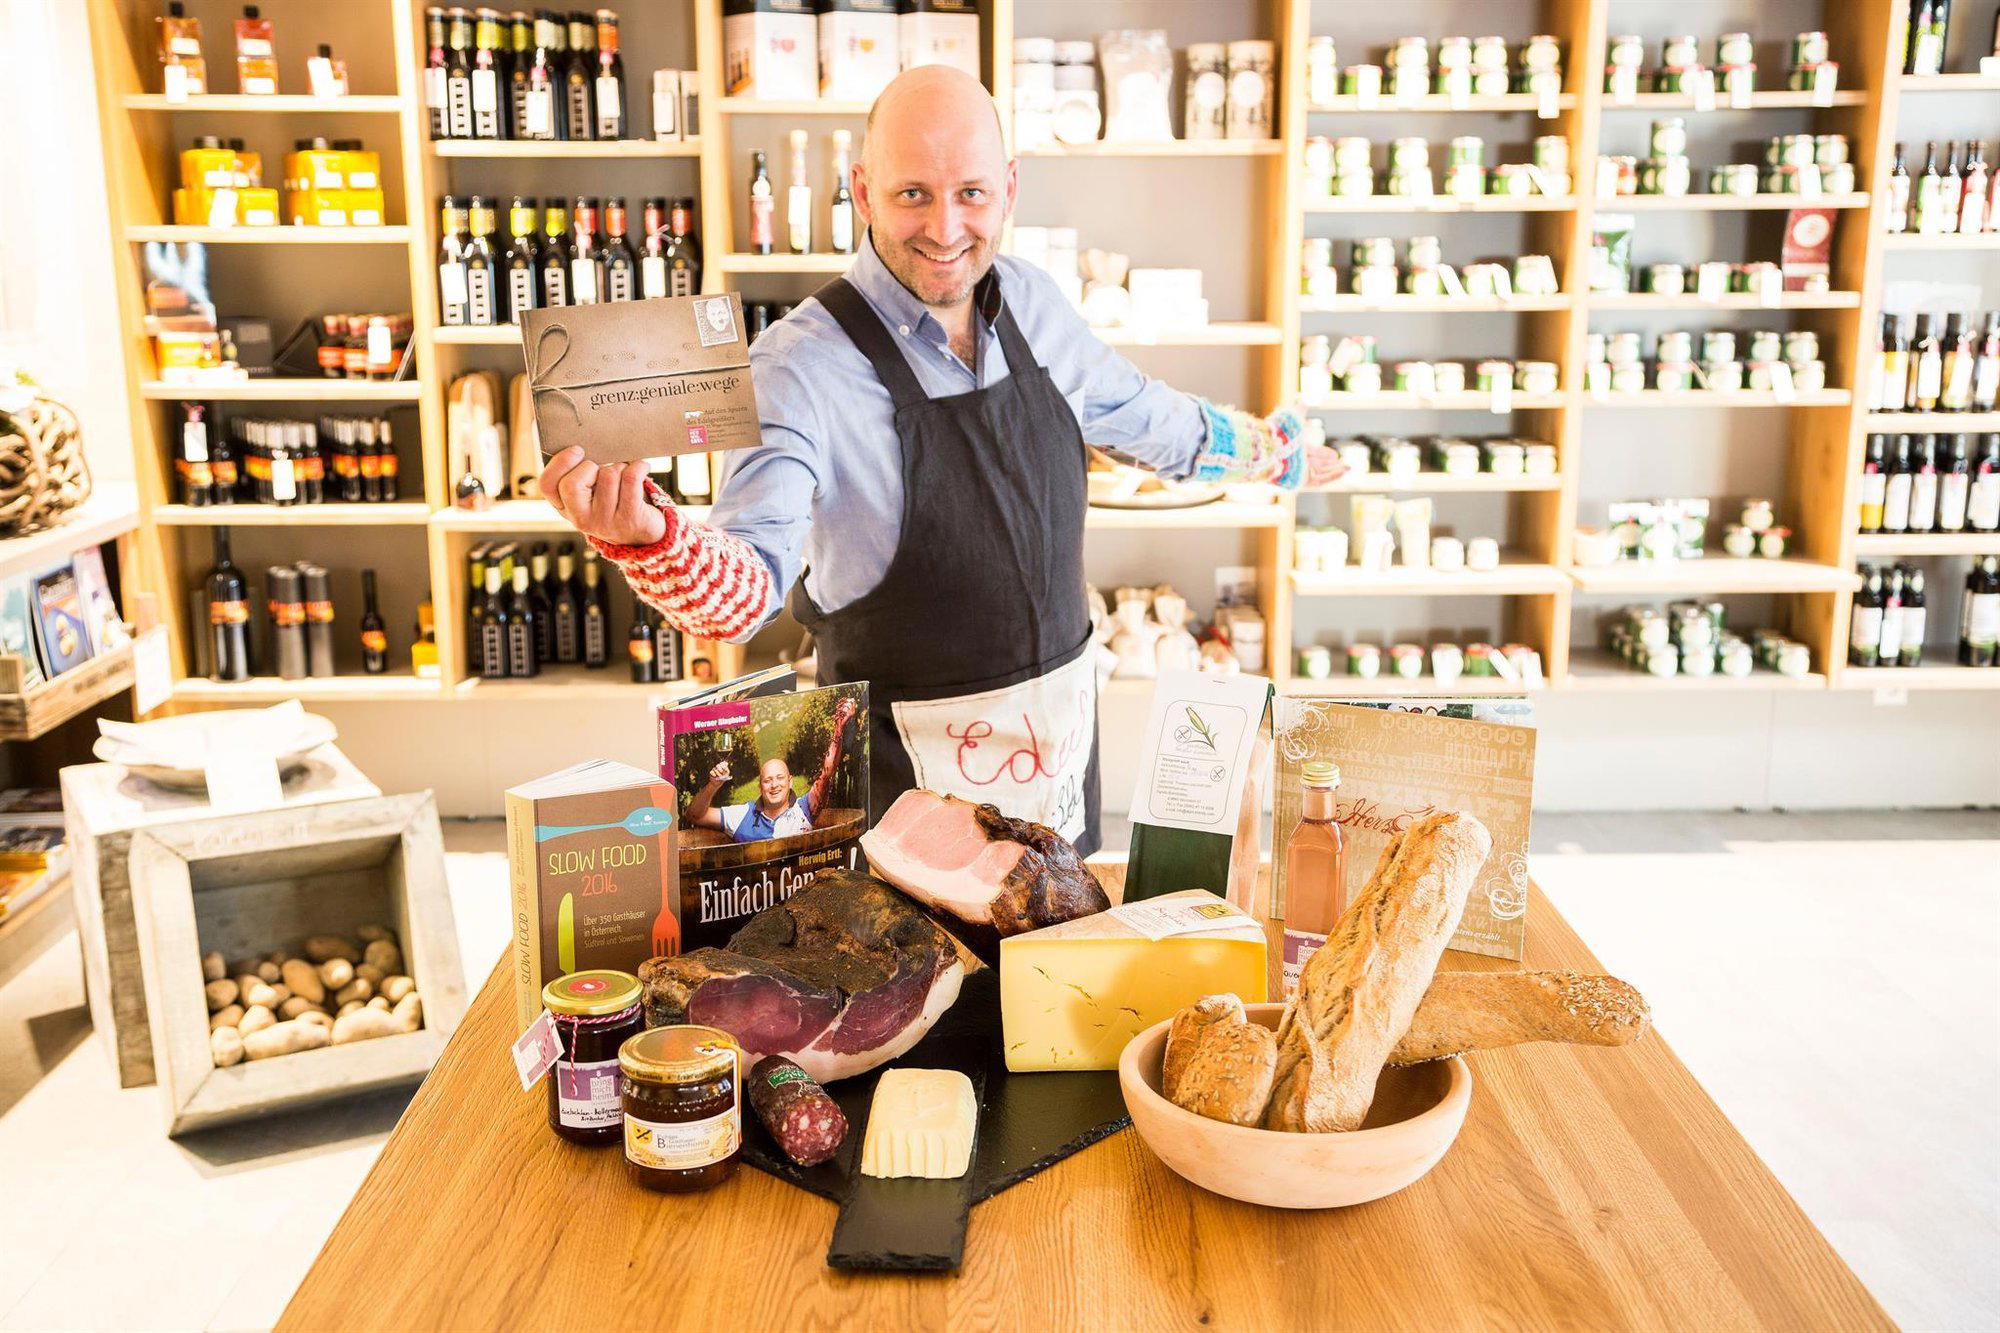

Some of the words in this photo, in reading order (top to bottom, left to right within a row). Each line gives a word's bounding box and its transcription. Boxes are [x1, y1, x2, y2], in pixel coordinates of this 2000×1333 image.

[590, 376, 740, 410] grenz:geniale:wege
[549, 848, 596, 876] SLOW
[602, 843, 648, 869] FOOD
[798, 852, 826, 867] Herwig
[518, 882, 528, 911] 2016
[581, 873, 618, 897] 2016
[699, 871, 774, 924] Einfach
[518, 912, 530, 948] FOOD
[599, 913, 612, 925] 350
[613, 909, 646, 922] Gasthäuser
[520, 949, 532, 987] SLOW
